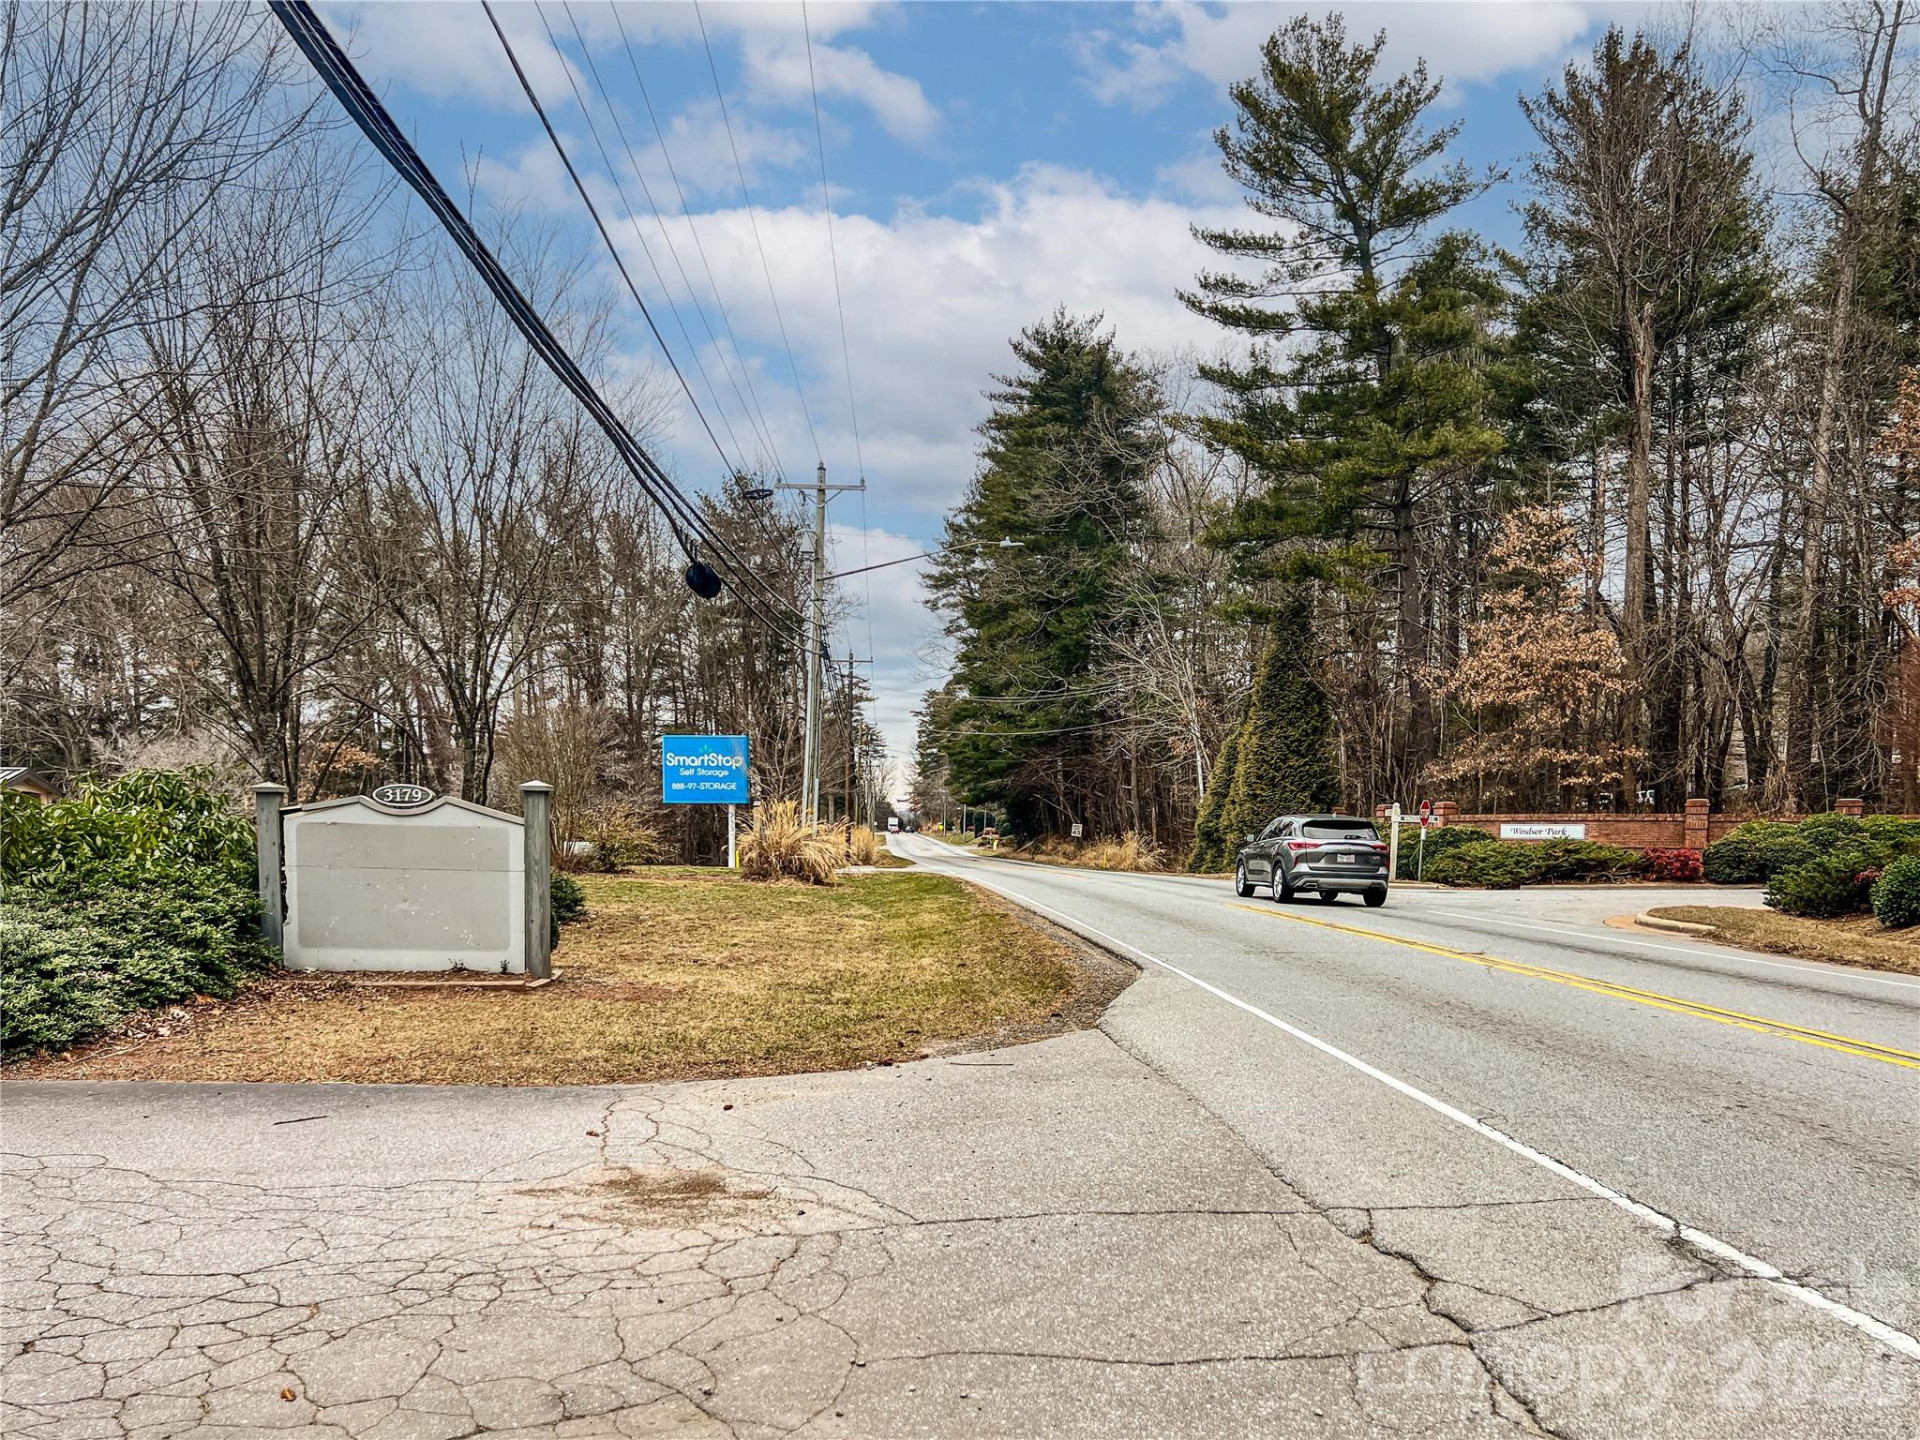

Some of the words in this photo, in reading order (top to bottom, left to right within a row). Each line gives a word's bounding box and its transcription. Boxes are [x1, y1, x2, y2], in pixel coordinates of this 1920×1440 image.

[666, 752, 742, 770] SmartStop
[679, 767, 695, 776] Self
[696, 767, 729, 778] Storage
[671, 782, 737, 791] 888-97-STORAGE
[383, 788, 422, 802] 3179
[1545, 826, 1567, 836] Park
